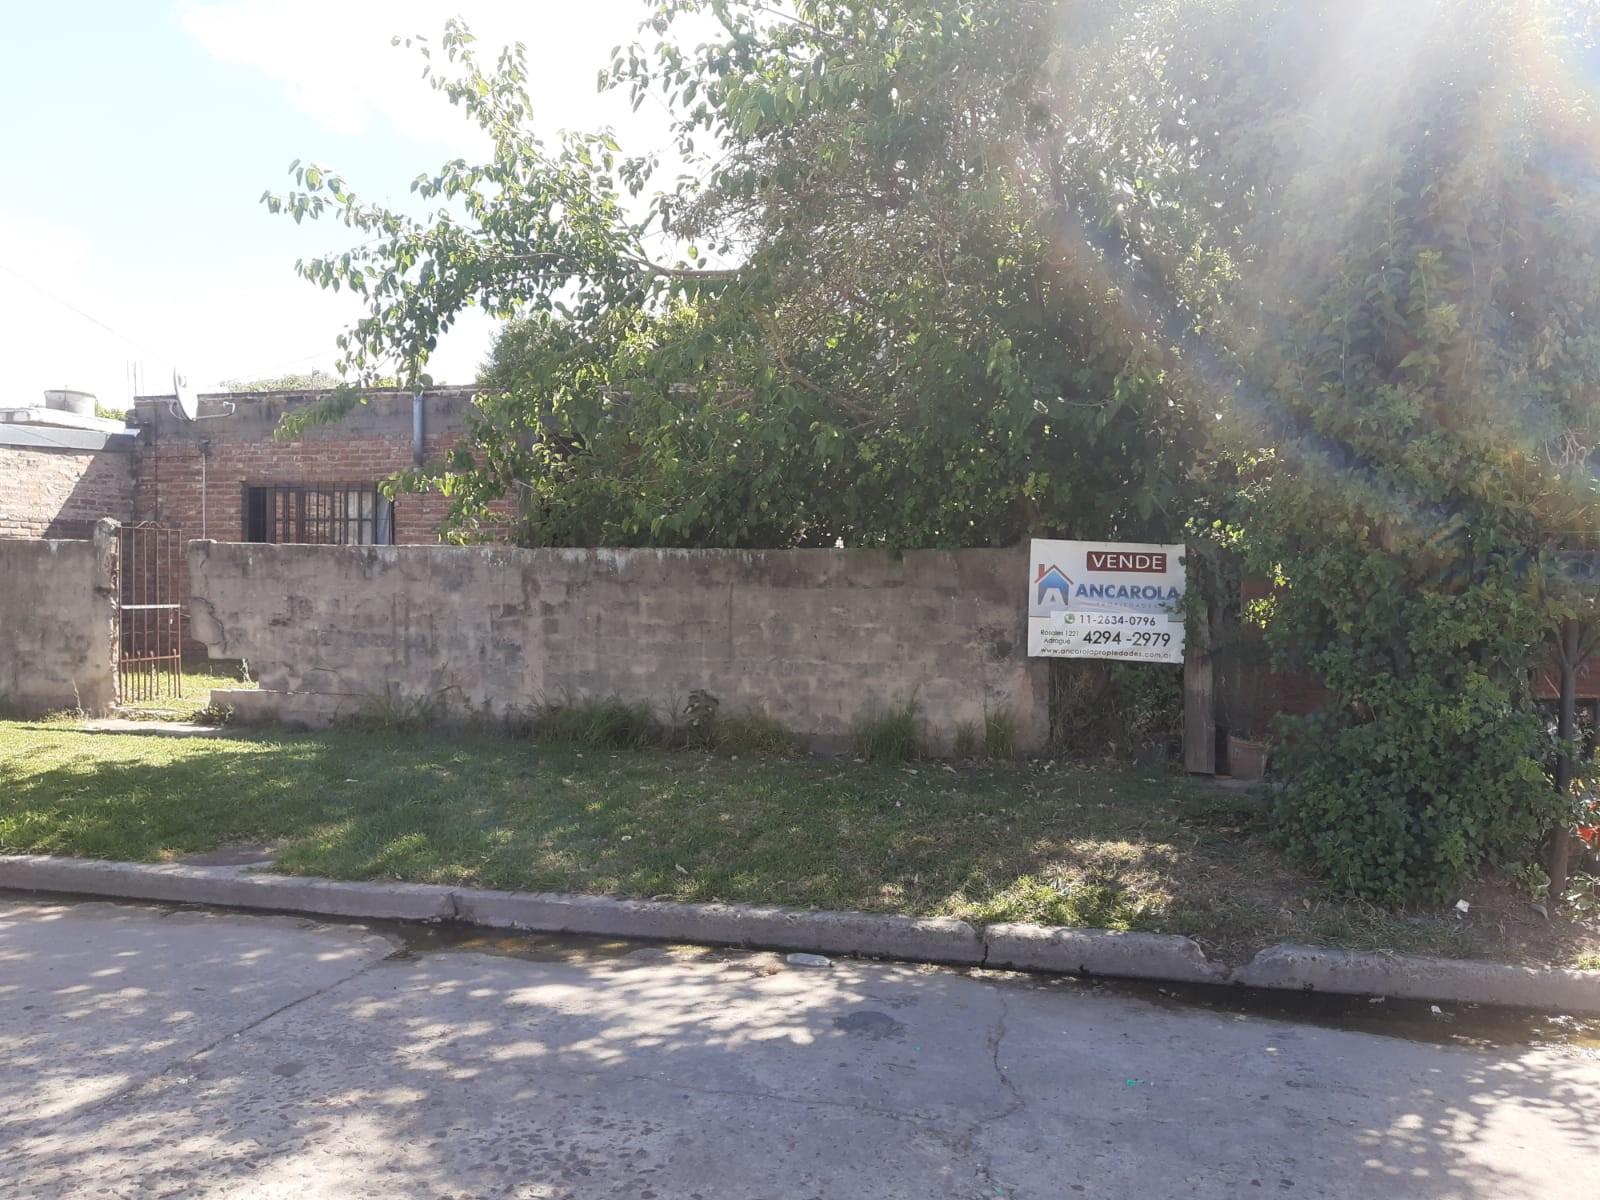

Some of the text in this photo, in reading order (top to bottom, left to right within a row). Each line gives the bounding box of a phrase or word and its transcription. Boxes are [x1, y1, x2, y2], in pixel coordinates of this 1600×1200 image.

[1092, 554, 1163, 570] VENDE
[1075, 584, 1180, 601] ANCAROLA
[1079, 614, 1156, 626] 11-2634-0796
